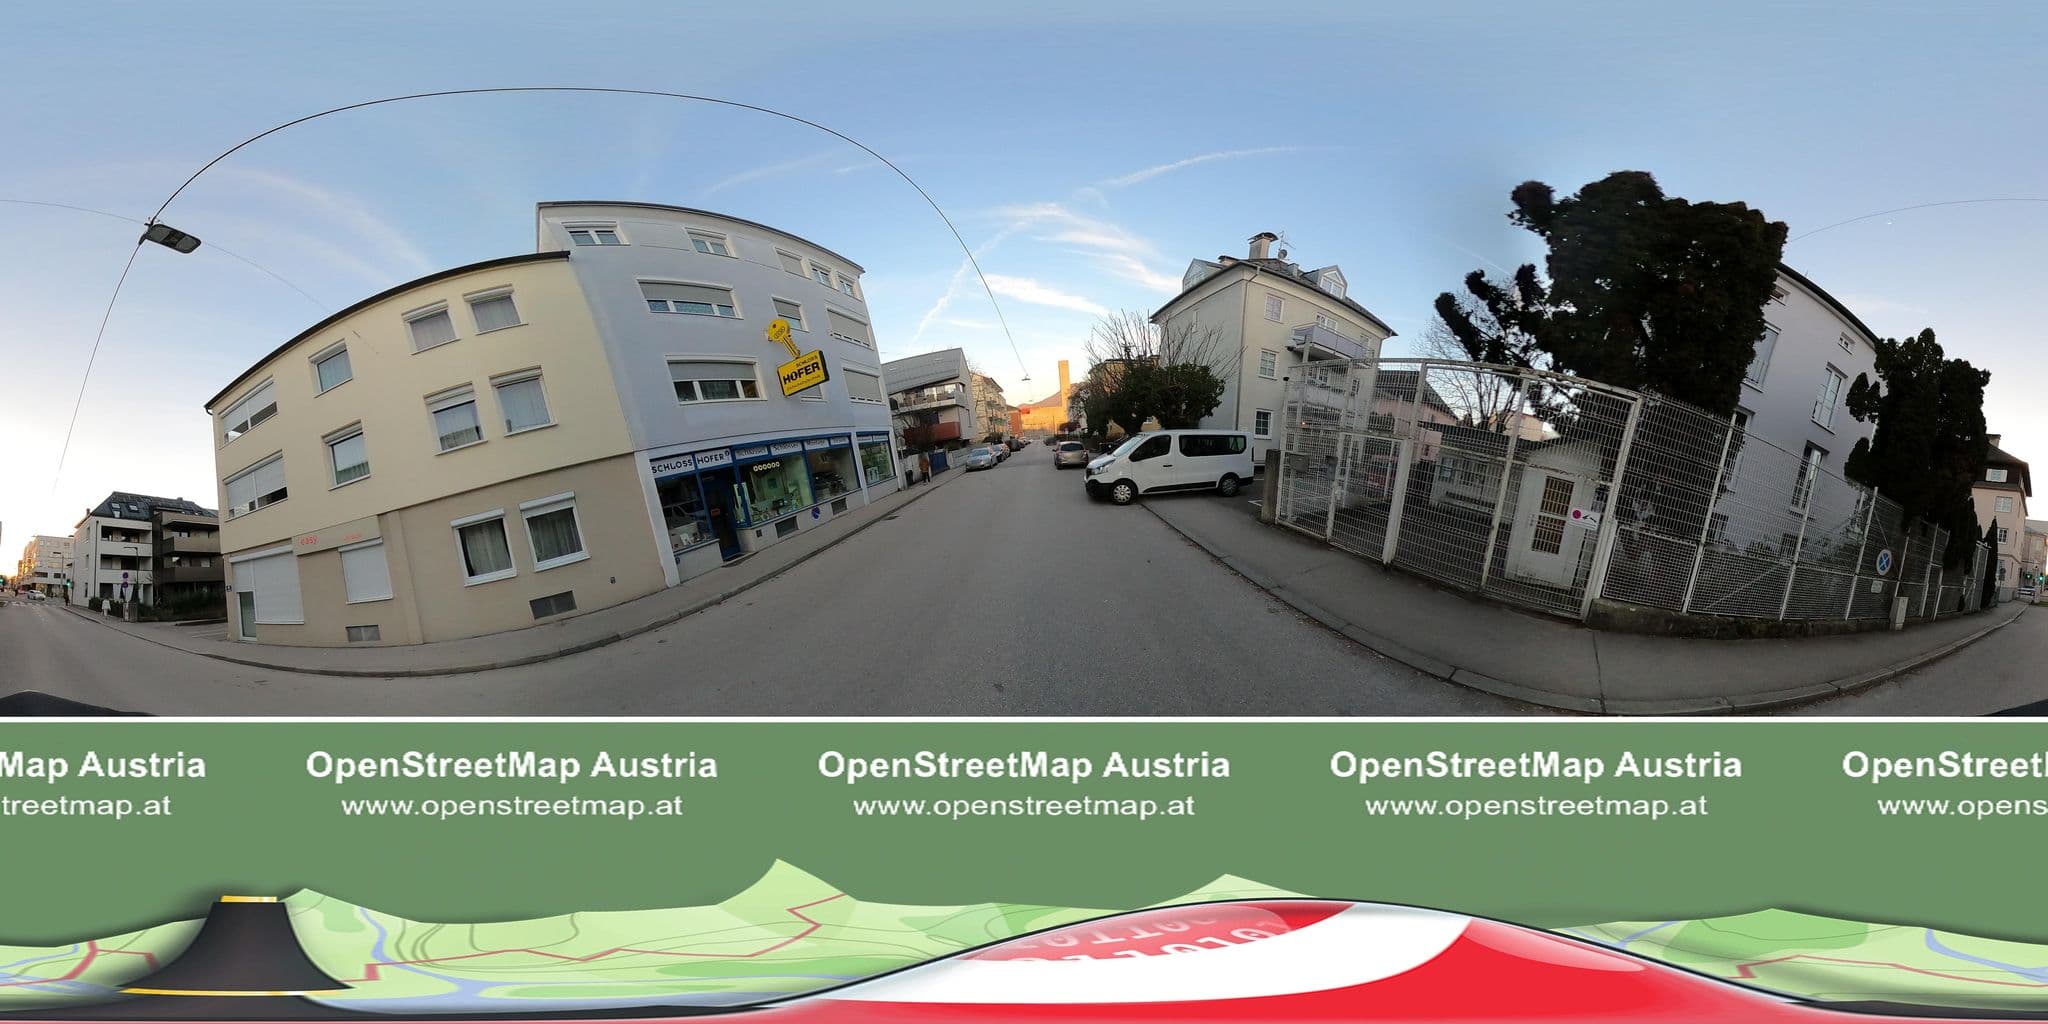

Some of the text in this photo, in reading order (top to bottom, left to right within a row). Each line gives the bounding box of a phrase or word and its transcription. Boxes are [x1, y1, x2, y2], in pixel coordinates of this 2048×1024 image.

[783, 362, 820, 384] HOFER
[651, 453, 724, 473] SCHLOSS HOFER
